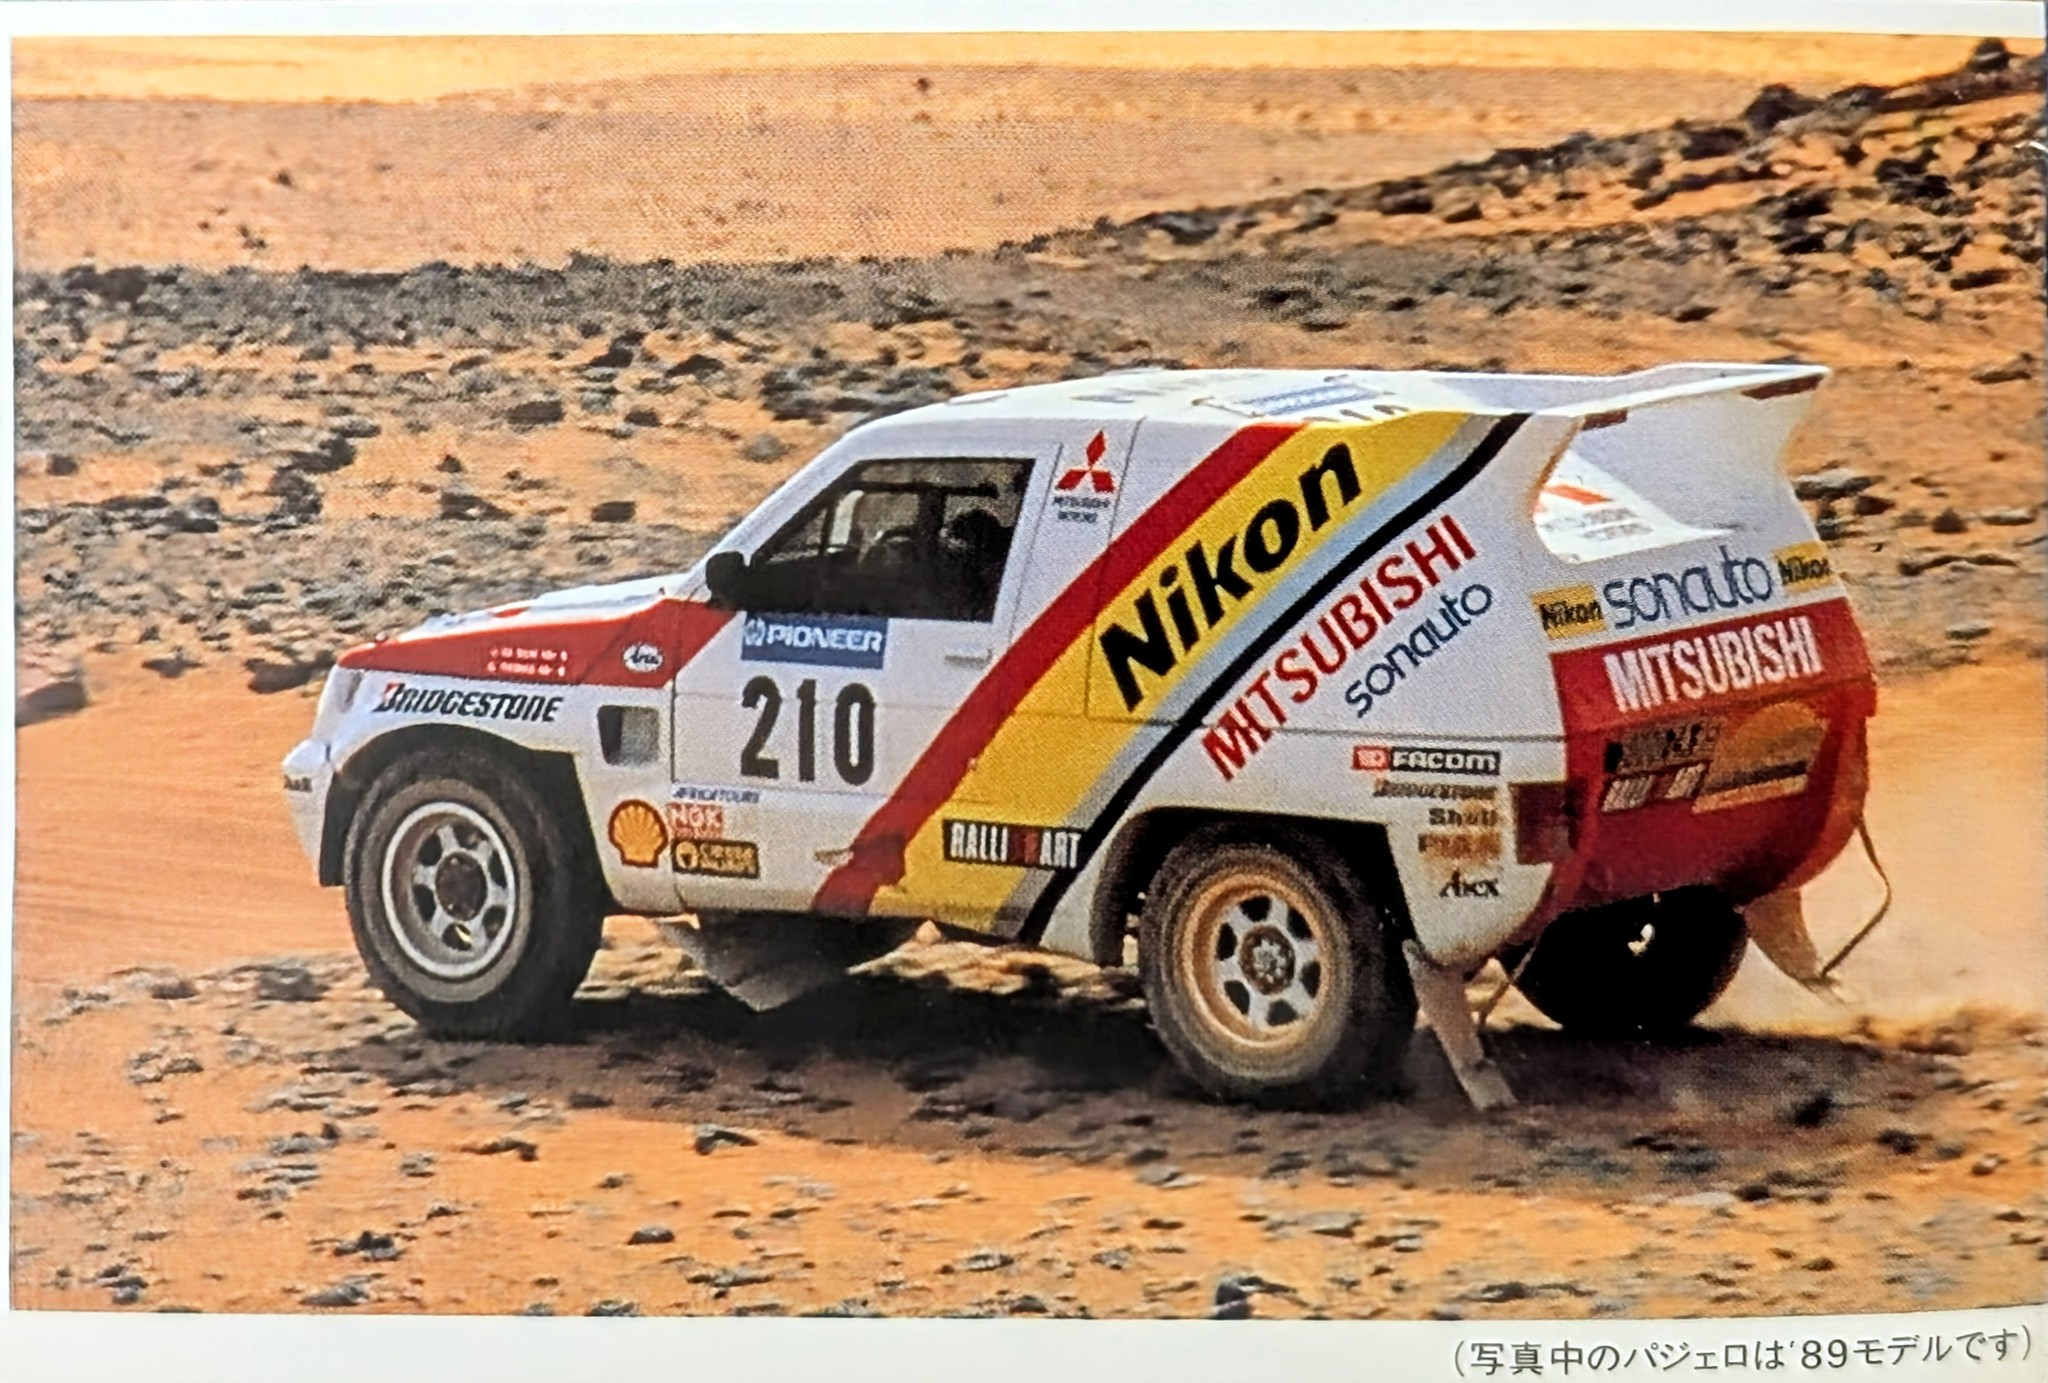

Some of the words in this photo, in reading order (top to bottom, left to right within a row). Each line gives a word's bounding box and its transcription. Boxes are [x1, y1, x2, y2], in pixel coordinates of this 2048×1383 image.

[1099, 442, 1362, 712] Nikon
[1539, 599, 1604, 632] Nikon
[1602, 544, 1774, 631] sonauto
[766, 624, 883, 653] PIONEER
[1201, 514, 1477, 782] MITSUBISHI
[1345, 583, 1493, 718] sonauto
[1603, 615, 1824, 714] MITSUBISHI
[372, 682, 564, 722] BRIDGESTONE
[740, 675, 876, 787] 210
[1393, 750, 1497, 771] FACOM
